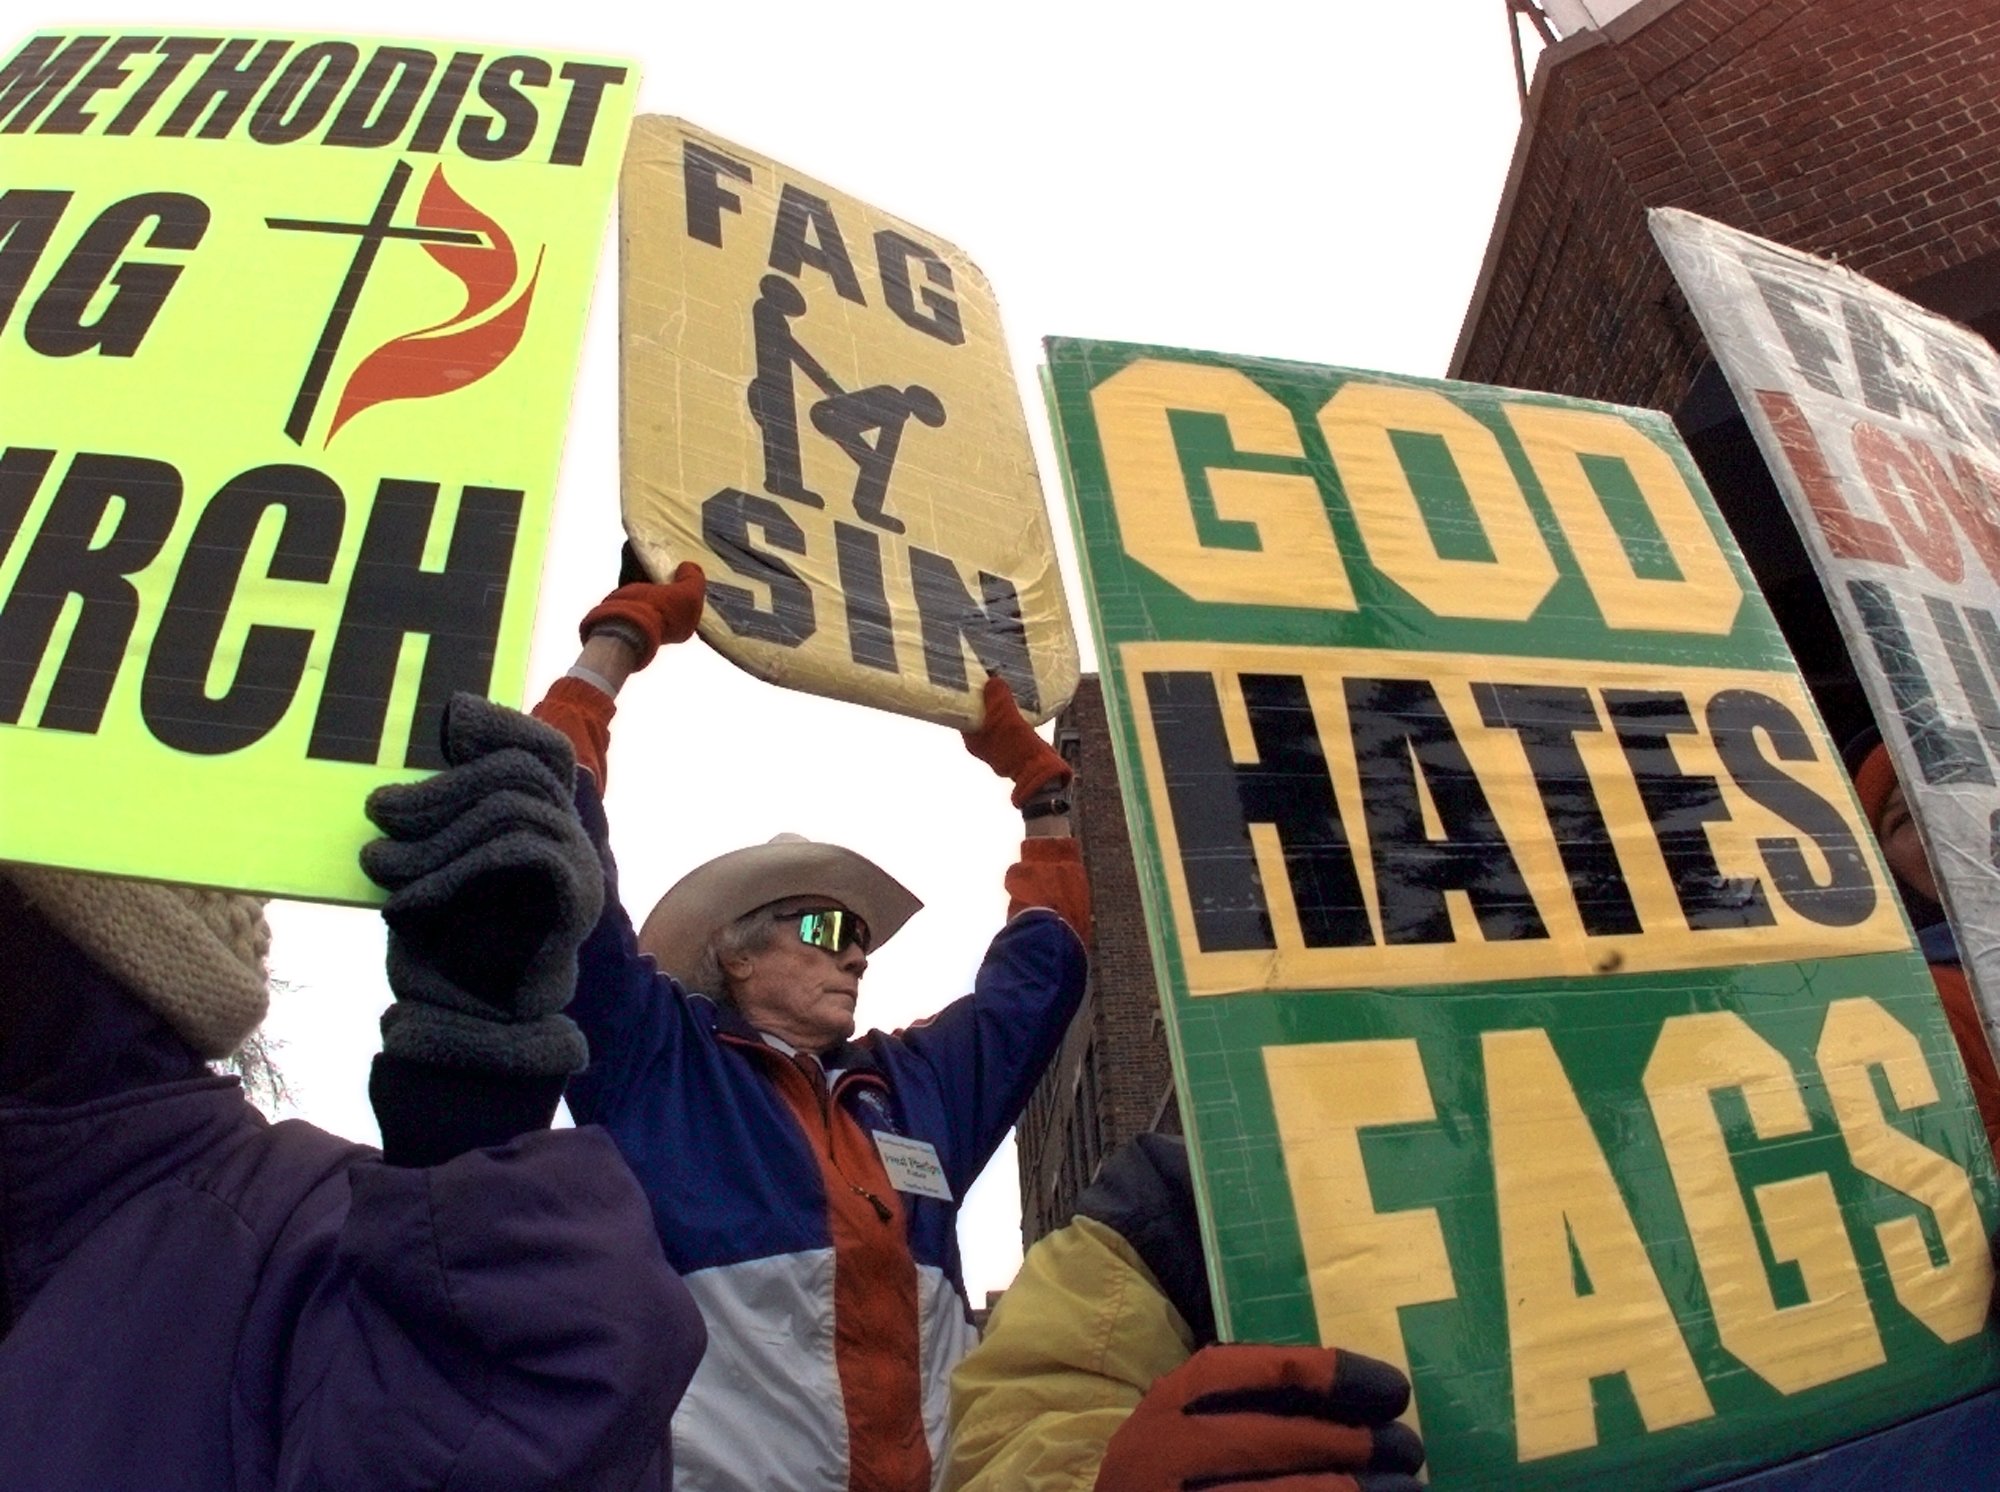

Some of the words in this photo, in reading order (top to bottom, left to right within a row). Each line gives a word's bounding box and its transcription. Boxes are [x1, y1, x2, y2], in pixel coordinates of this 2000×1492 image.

[0, 36, 628, 166] METHODIST
[682, 140, 965, 346] FAG
[0, 446, 525, 771] RCH
[702, 487, 1040, 713] SIN
[1091, 359, 1744, 636] GOD
[1143, 671, 1877, 954] HATES
[1262, 996, 1995, 1483] FAGS
